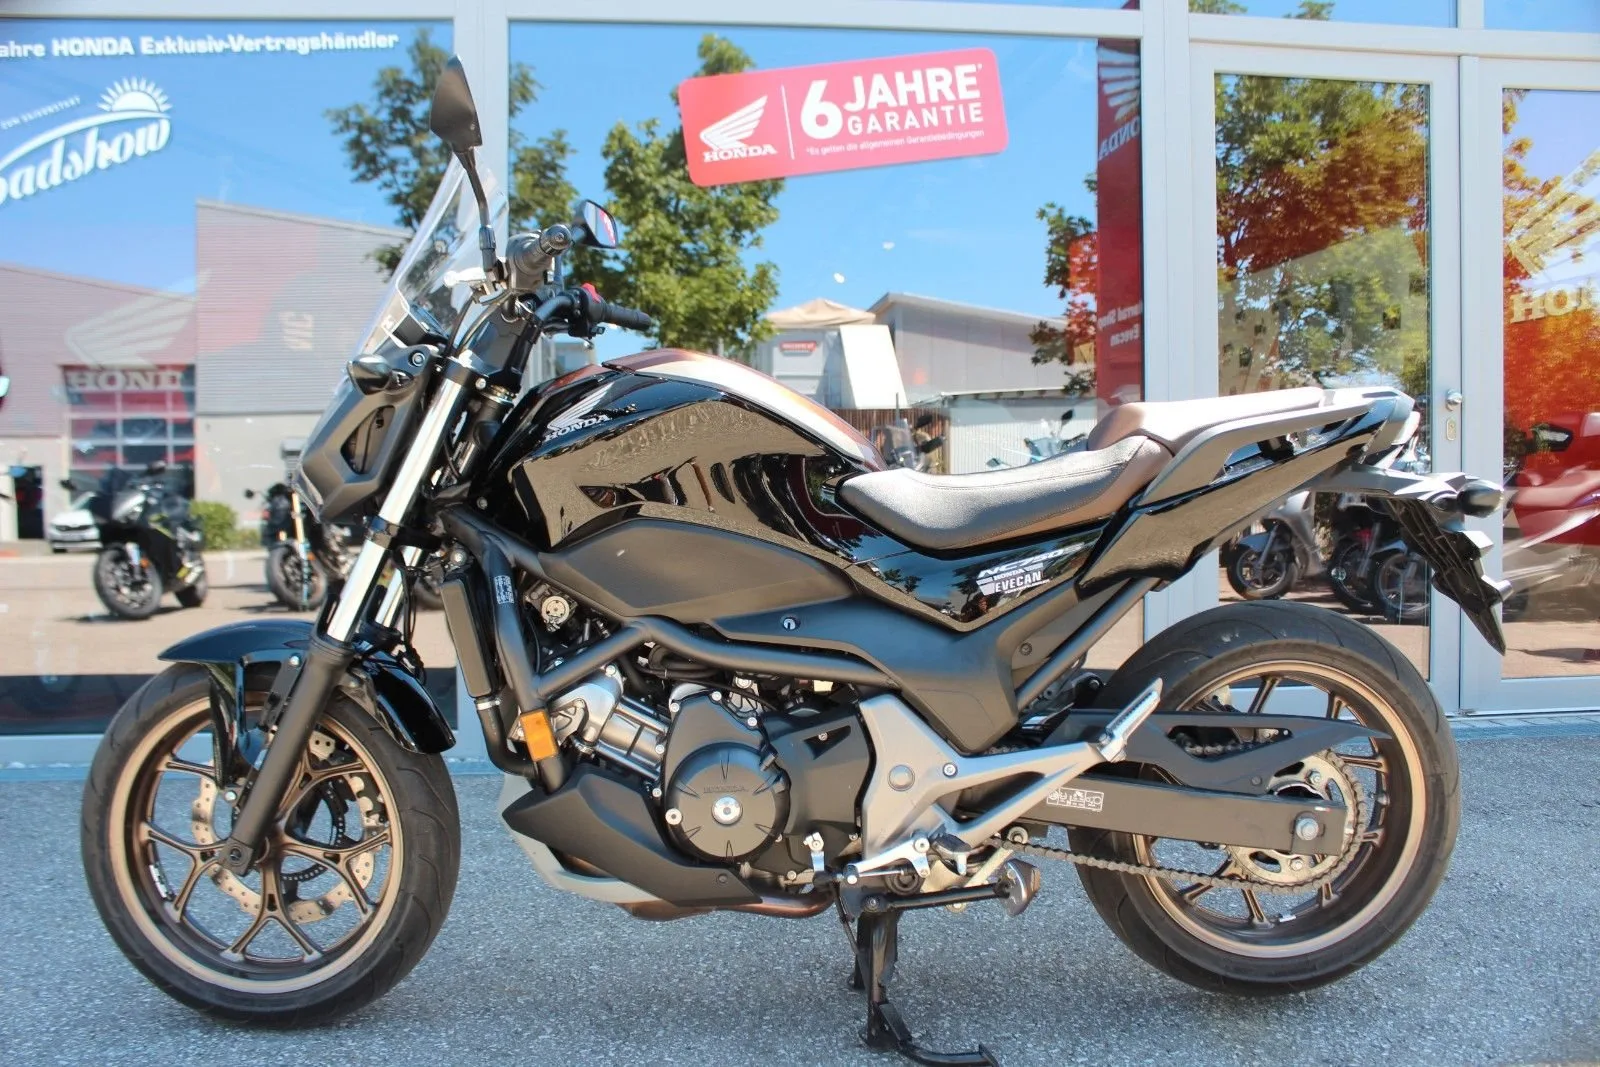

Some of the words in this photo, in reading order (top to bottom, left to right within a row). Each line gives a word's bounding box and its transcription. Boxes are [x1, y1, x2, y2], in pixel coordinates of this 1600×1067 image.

[52, 37, 135, 57] HONDA
[140, 31, 399, 56] Exklusiv-Vertragshändler
[800, 80, 843, 140] 6
[847, 102, 983, 136] GARANTIE
[703, 143, 777, 163] HONDA
[859, 138, 904, 151] allgemeinen
[906, 129, 985, 145] Garantiebedingungen
[545, 414, 610, 441] HONDA
[995, 570, 1042, 593] EVECAN
